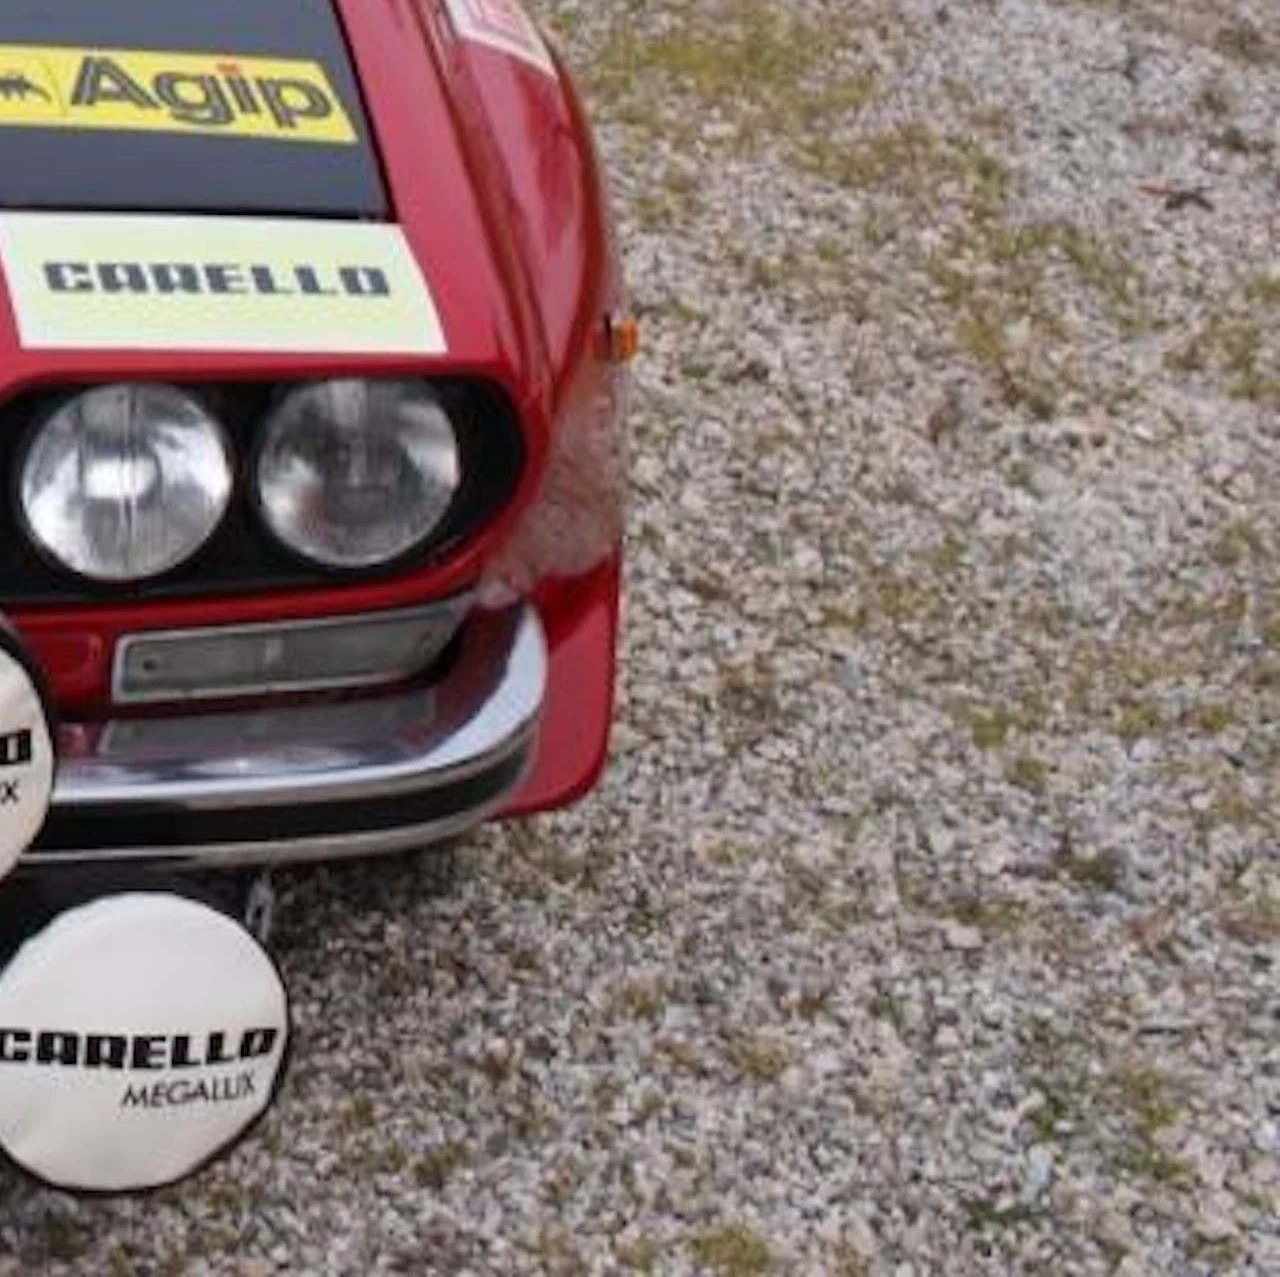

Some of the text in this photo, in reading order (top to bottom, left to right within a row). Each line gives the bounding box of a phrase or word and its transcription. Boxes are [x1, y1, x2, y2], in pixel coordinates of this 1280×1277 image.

[70, 56, 333, 128] Agip
[42, 262, 390, 297] CARELLO
[120, 1071, 256, 1109] MEGALUX
